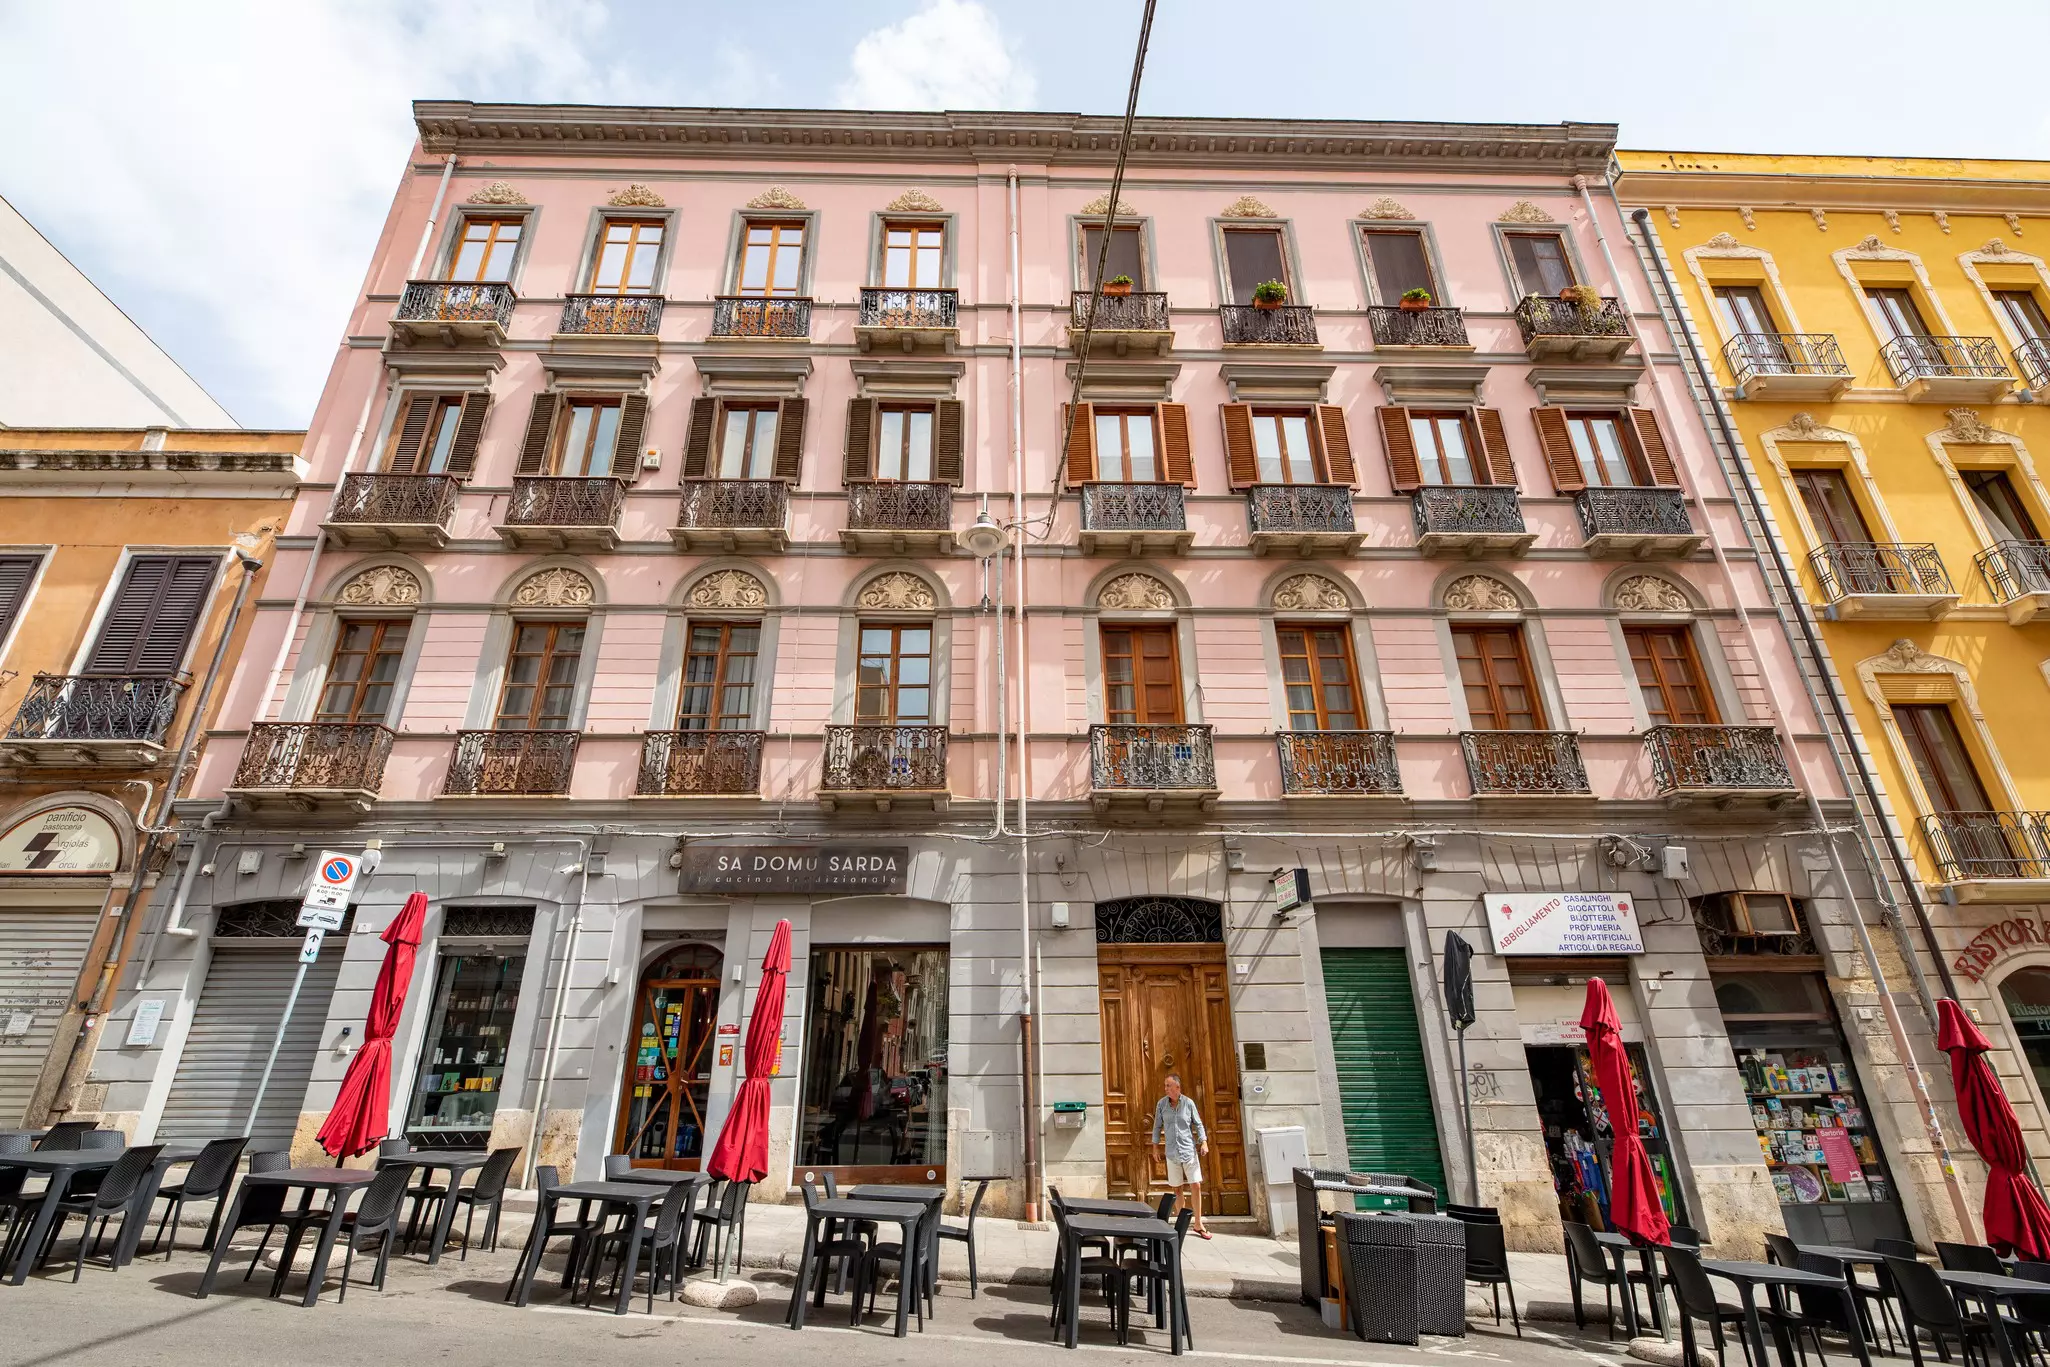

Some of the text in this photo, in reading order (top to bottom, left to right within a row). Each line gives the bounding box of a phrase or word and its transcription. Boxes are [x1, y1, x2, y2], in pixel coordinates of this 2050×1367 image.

[46, 812, 87, 823] panificio
[46, 833, 89, 850] Argiolas
[717, 856, 897, 871] SA DOMU SARDA
[715, 874, 897, 884] cucina tradizionale
[1567, 904, 1614, 912] GIOCATTOLI
[1499, 898, 1561, 949] ABBIGLIAMENTO
[1570, 914, 1616, 922] BIJOTTERIA
[1954, 918, 2050, 984] RISTOR
